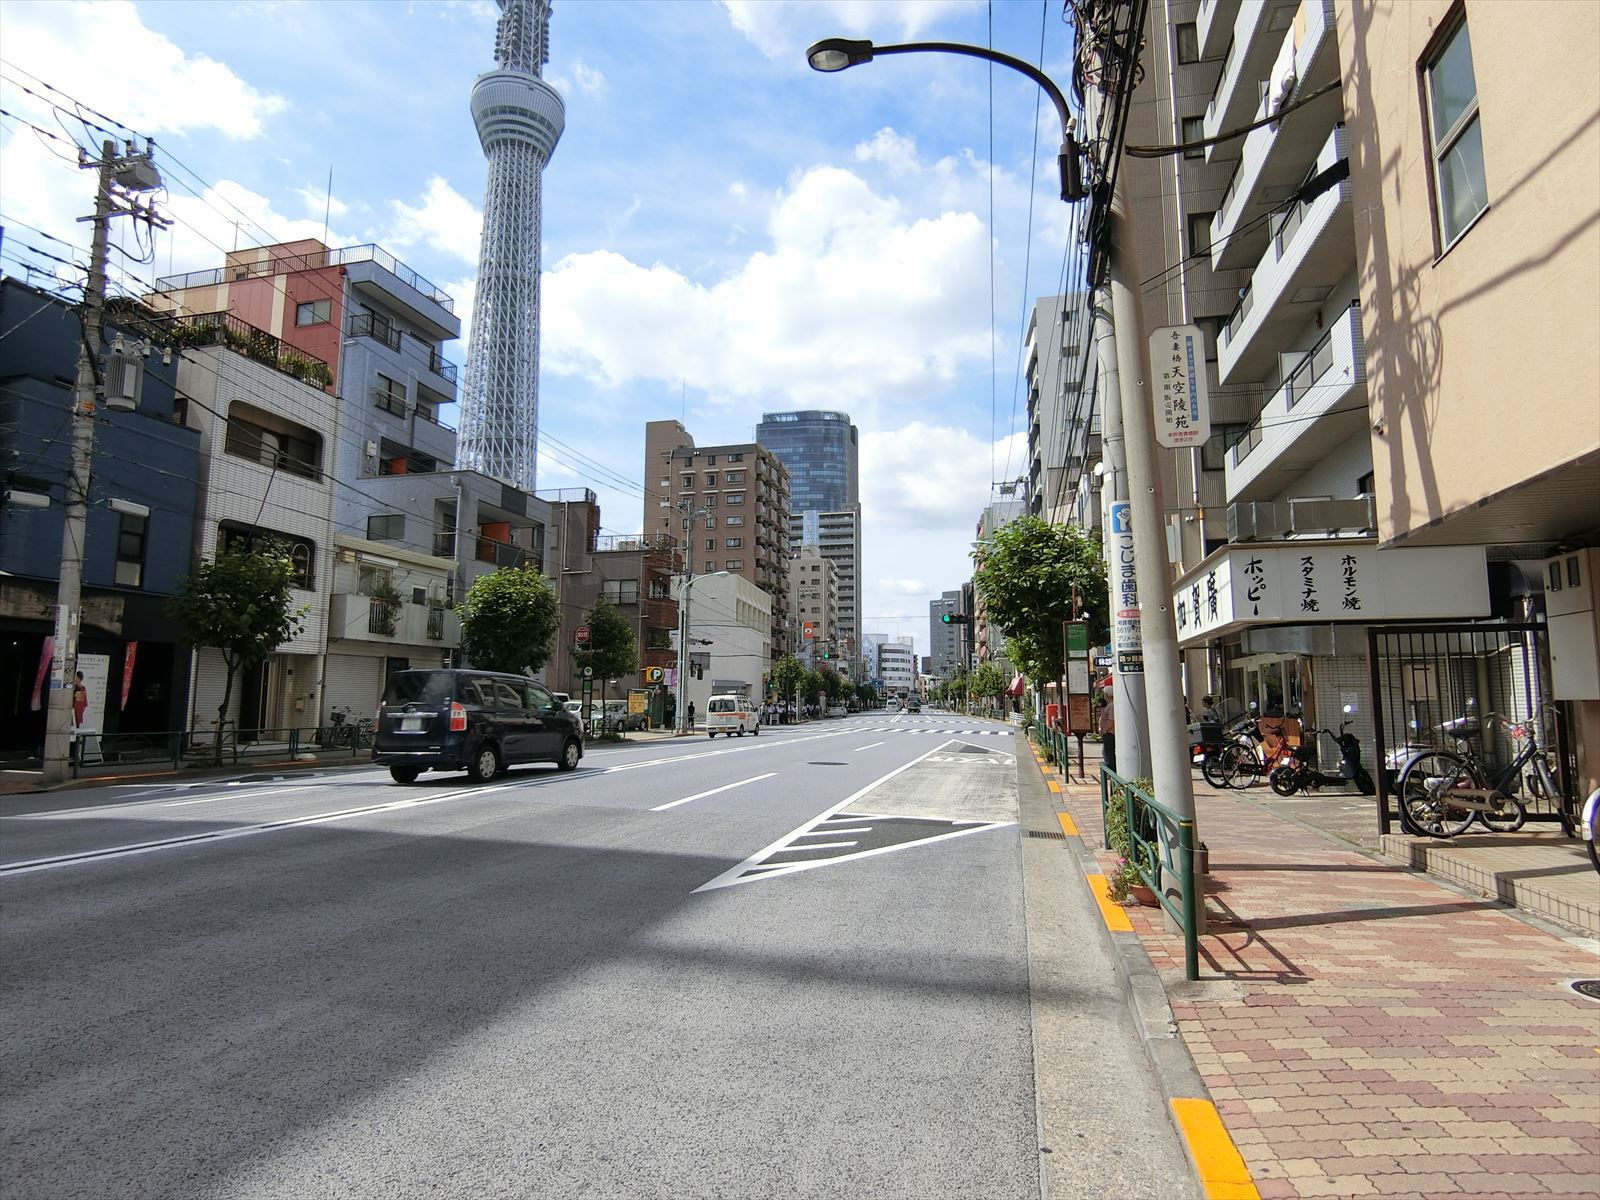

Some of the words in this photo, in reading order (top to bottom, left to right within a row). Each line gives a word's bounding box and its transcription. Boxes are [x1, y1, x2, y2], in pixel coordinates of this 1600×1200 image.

[1120, 535, 1138, 607] こじま歯科
[1244, 554, 1266, 616] ホッピー
[1301, 555, 1319, 612] スタミナ焼
[1341, 554, 1361, 610] ホルモン焼
[653, 670, 662, 680] P
